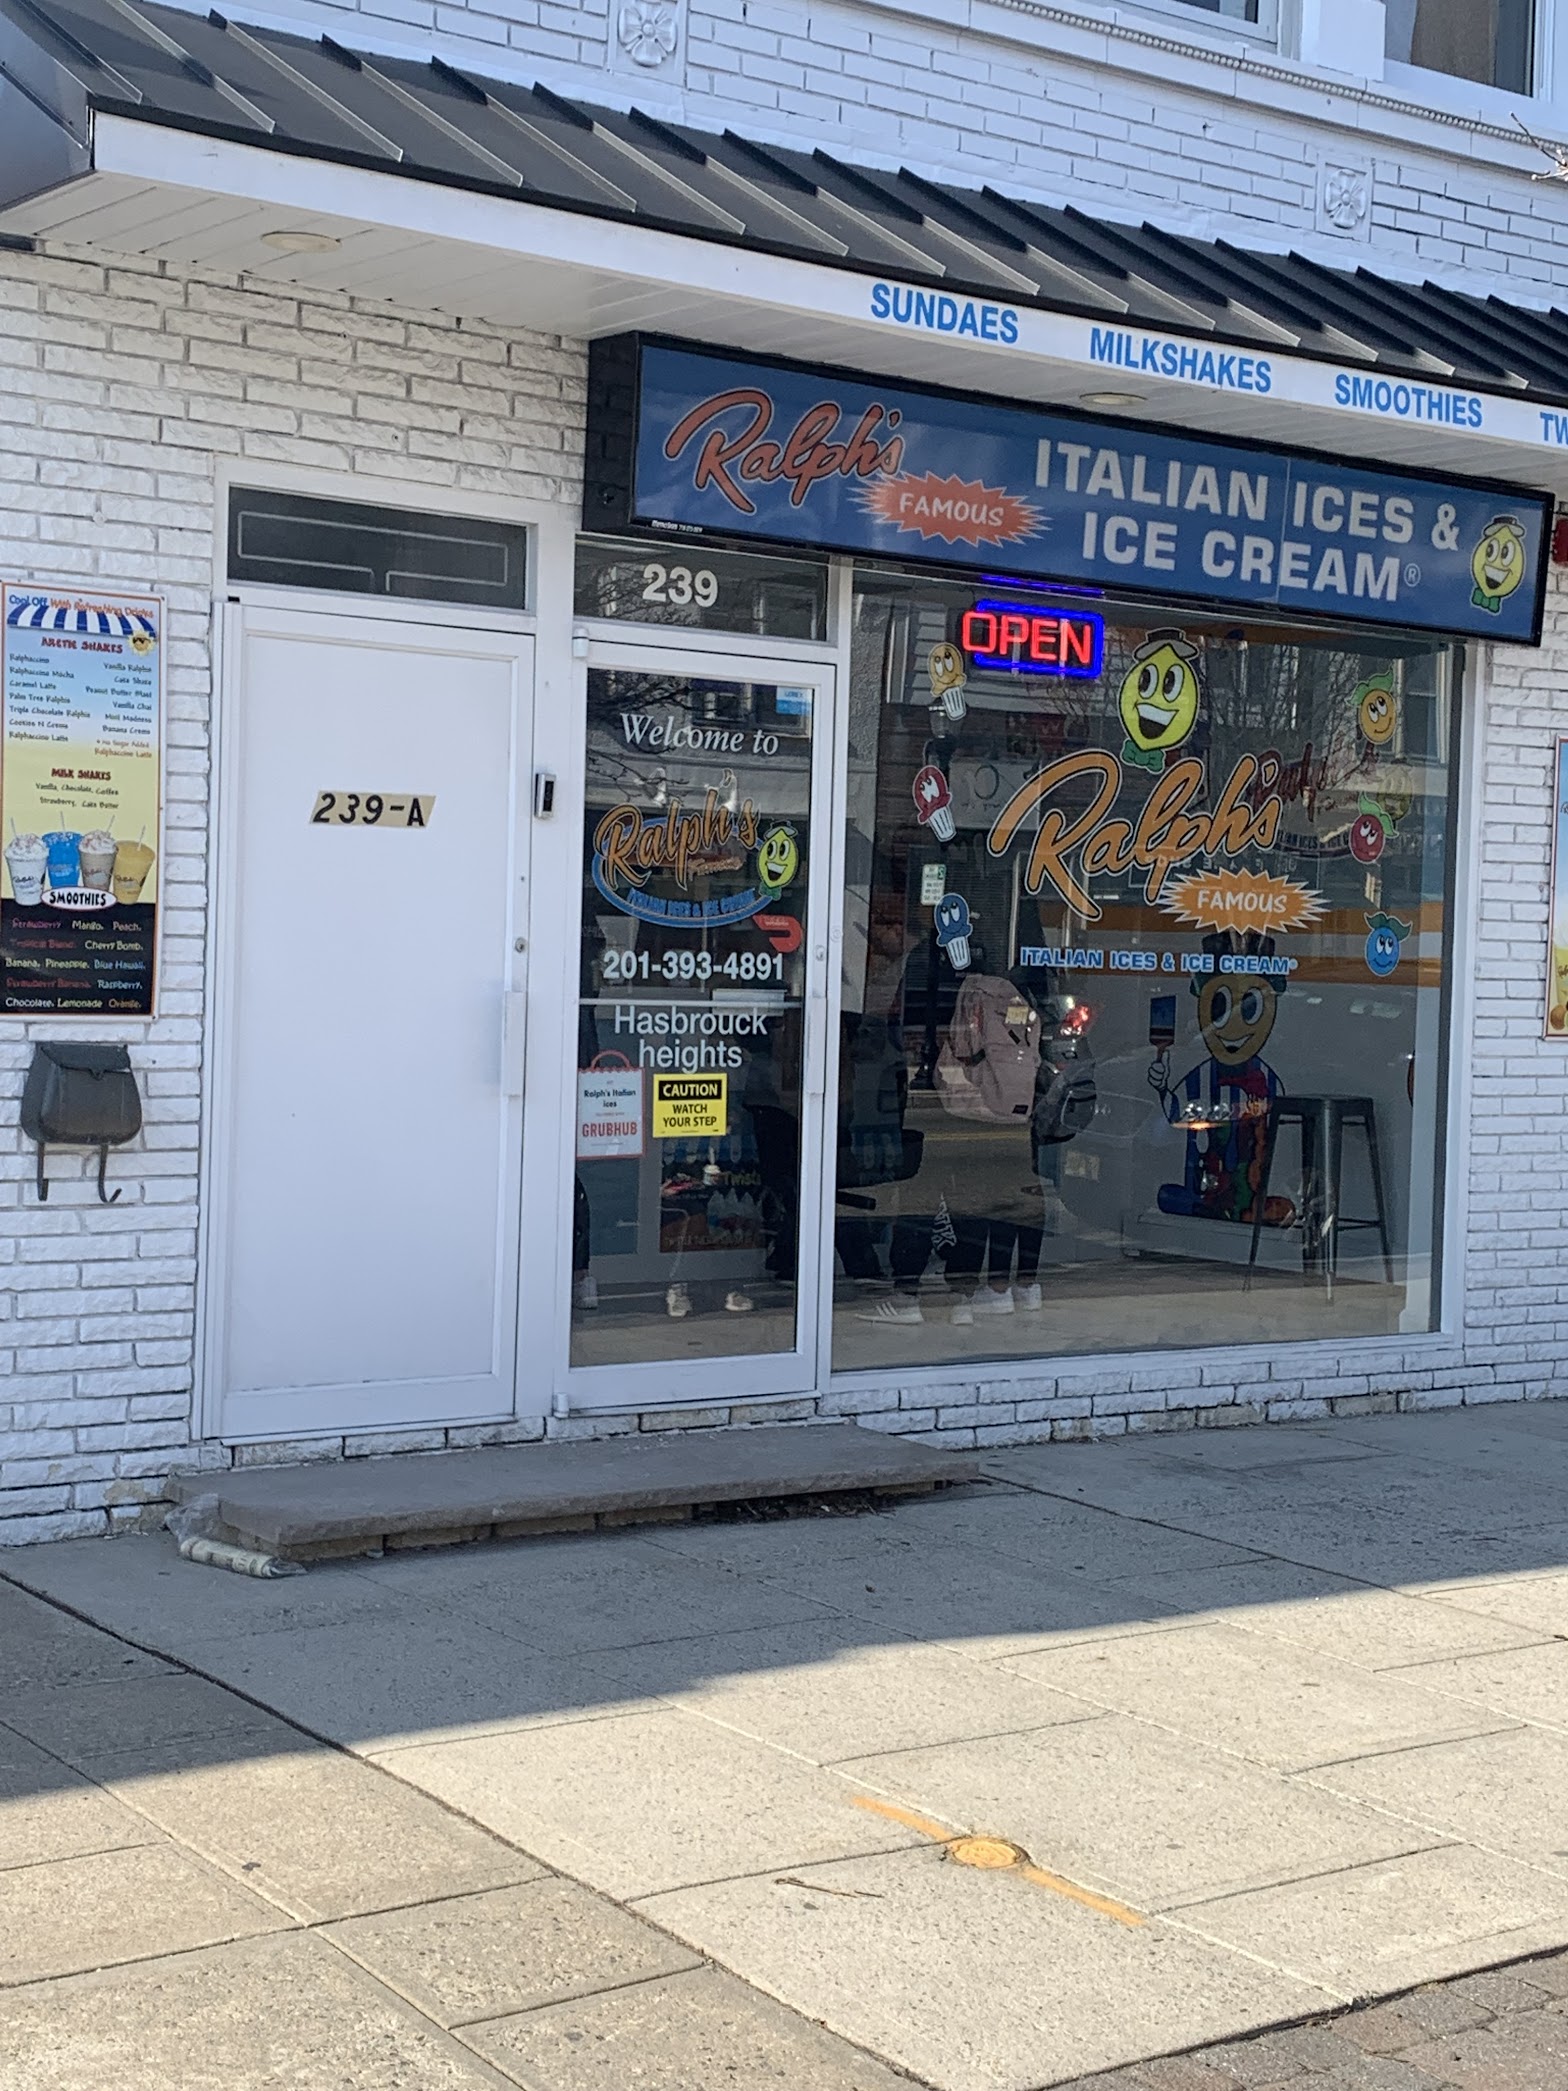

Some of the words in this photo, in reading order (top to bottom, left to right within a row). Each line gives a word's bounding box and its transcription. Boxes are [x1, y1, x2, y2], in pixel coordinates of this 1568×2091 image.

[871, 283, 1018, 344] SUNDAES
[1090, 327, 1271, 393] MILKSHAKES
[1335, 374, 1483, 427] SMOOTHIES
[665, 388, 905, 514] Ralph's
[900, 491, 1004, 527] FAMOUS
[1034, 438, 1269, 521] ITALIAN
[1292, 481, 1414, 544] ICES
[1431, 503, 1458, 551] &
[1082, 510, 1177, 571] ICE
[9, 594, 30, 605] Cool
[32, 596, 48, 607] Off
[642, 562, 719, 608] 239
[41, 636, 77, 650] ARCTIC
[81, 640, 123, 654] SHAKES
[962, 609, 1091, 664] OPEN
[620, 712, 744, 752] Welcome
[753, 729, 779, 755] to
[77, 769, 111, 781] SHAKES
[313, 793, 425, 827] 239-A
[594, 768, 760, 891] Ralph's
[989, 749, 1282, 919] Ralph's
[49, 891, 106, 906] SMOOTHIES
[1197, 889, 1287, 913] FAMOUS
[85, 940, 115, 950] Cherry
[1021, 947, 1104, 969] ITALIAN
[1109, 950, 1157, 971] ICES
[1161, 952, 1175, 972] &
[1181, 953, 1214, 973] ICE
[603, 950, 783, 980] 201-393-4891
[614, 1005, 768, 1036] Hasbrouck
[639, 1038, 742, 1074] heights
[584, 1089, 610, 1099] Ralph's
[662, 1083, 718, 1097] CAUTION
[663, 1116, 690, 1128] YOUR
[693, 1116, 717, 1126] STEP
[672, 1103, 707, 1114] WATCH
[582, 1121, 637, 1137] GRUBHUB
